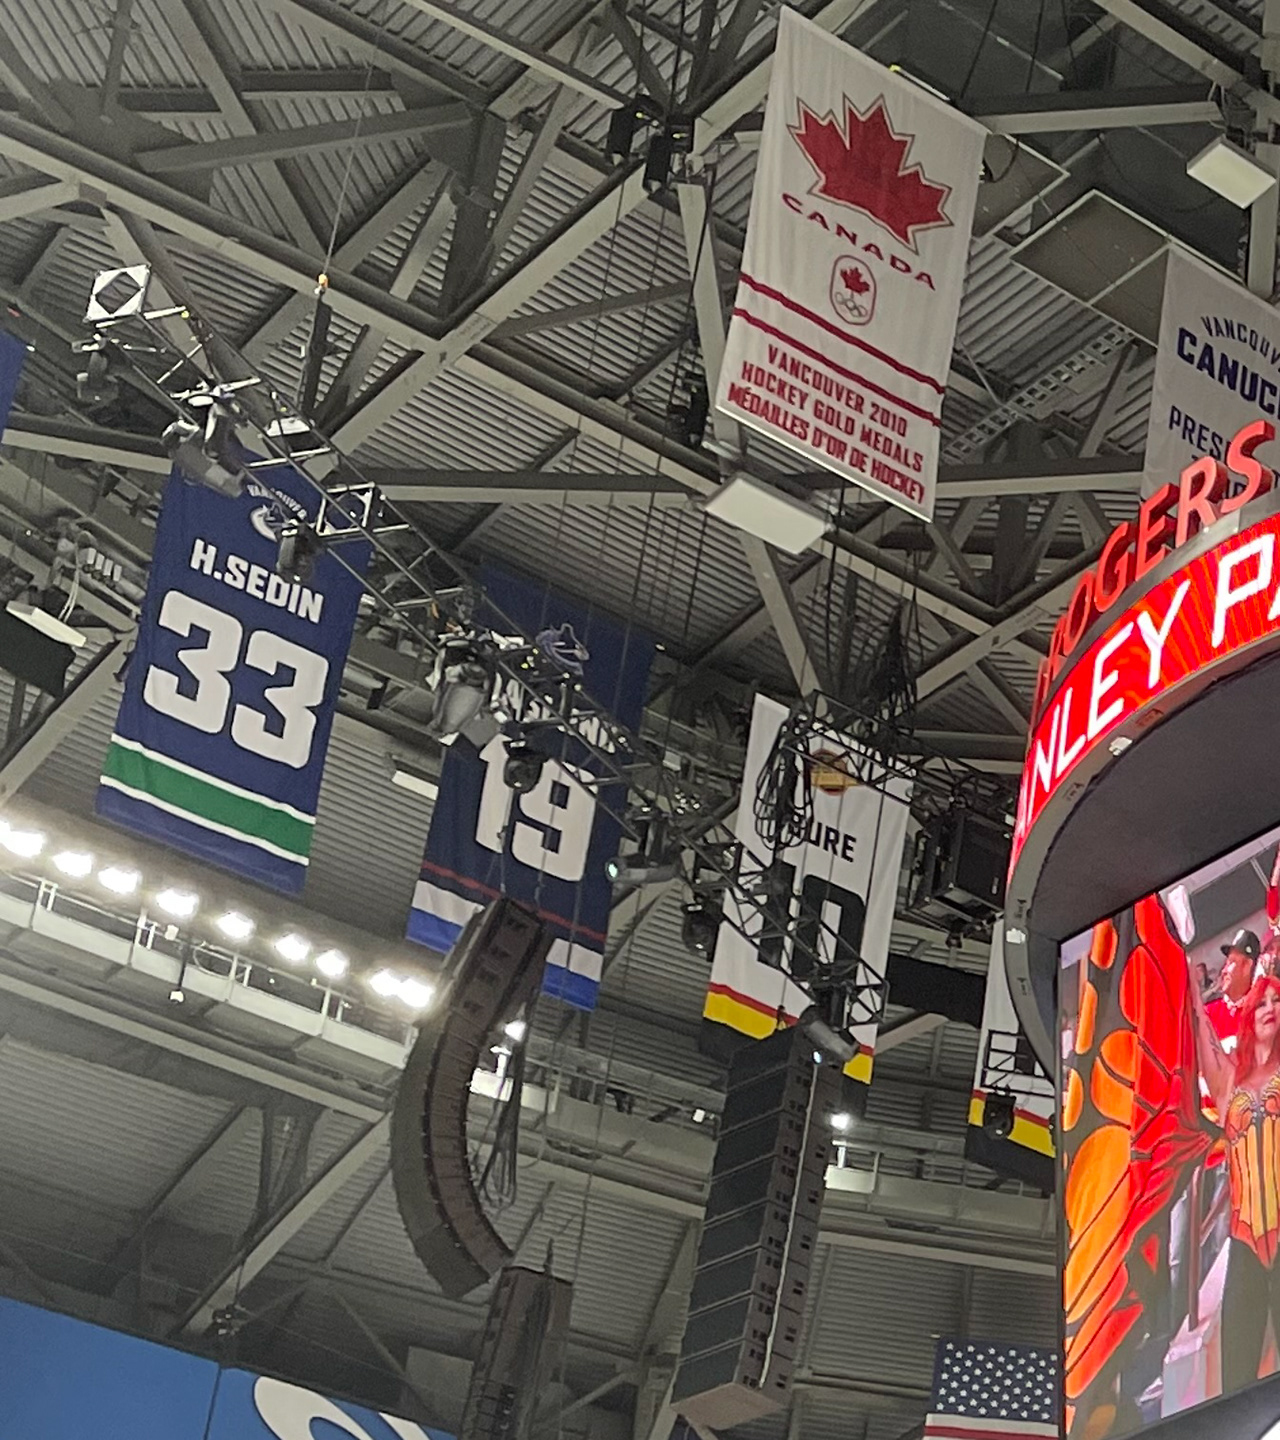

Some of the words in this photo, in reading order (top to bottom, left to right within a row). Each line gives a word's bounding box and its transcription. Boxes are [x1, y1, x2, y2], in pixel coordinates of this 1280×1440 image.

[782, 192, 936, 291] CANADA
[727, 382, 810, 441] MÉDAILLES
[849, 452, 867, 473] DE
[869, 460, 926, 505] HOCKEY
[742, 360, 810, 411] HOCKEY
[813, 403, 855, 437] GOLD
[859, 426, 924, 474] MEDALS
[768, 343, 865, 415] VANCOUVER
[869, 402, 908, 438] 2010
[190, 537, 325, 624] H.SEDIN
[142, 589, 331, 770] 33
[474, 733, 600, 882] 19
